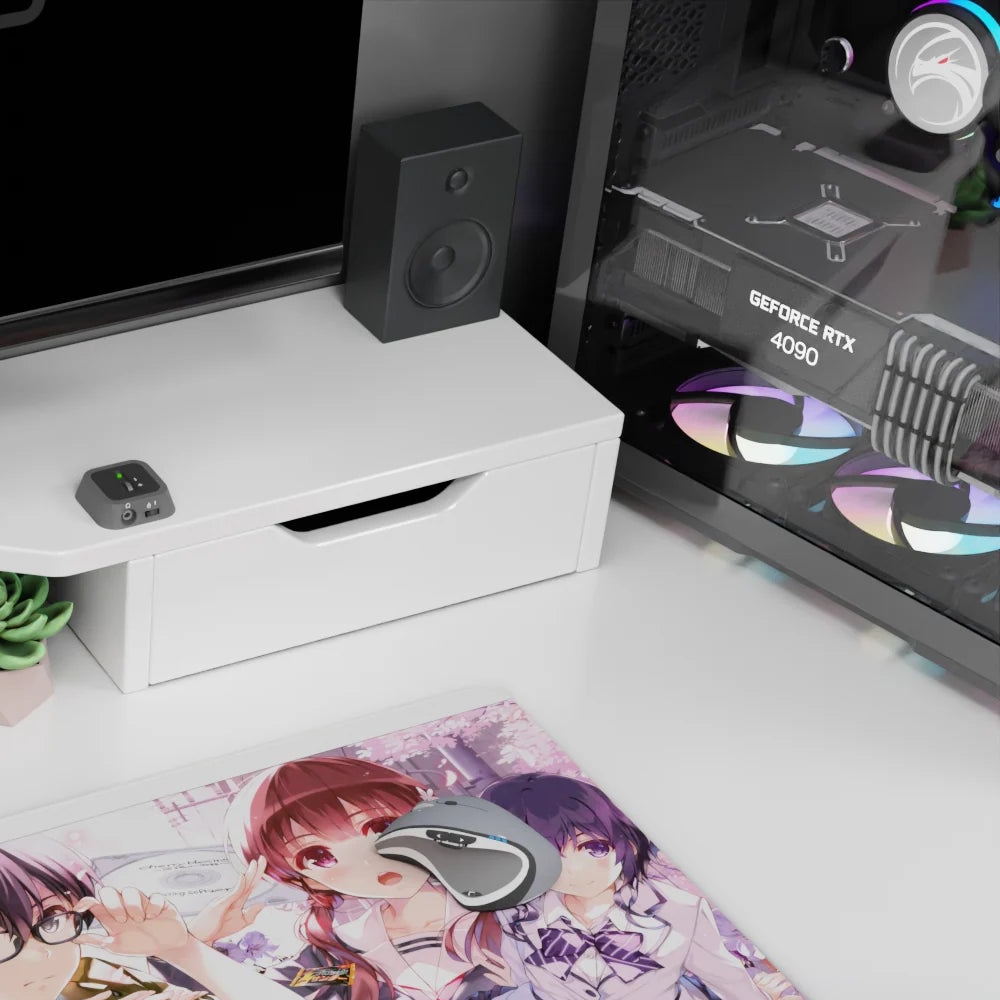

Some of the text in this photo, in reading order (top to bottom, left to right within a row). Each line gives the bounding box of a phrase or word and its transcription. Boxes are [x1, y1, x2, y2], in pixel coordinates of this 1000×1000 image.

[749, 289, 857, 354] GEFORCE RTX
[769, 331, 819, 367] 4090
